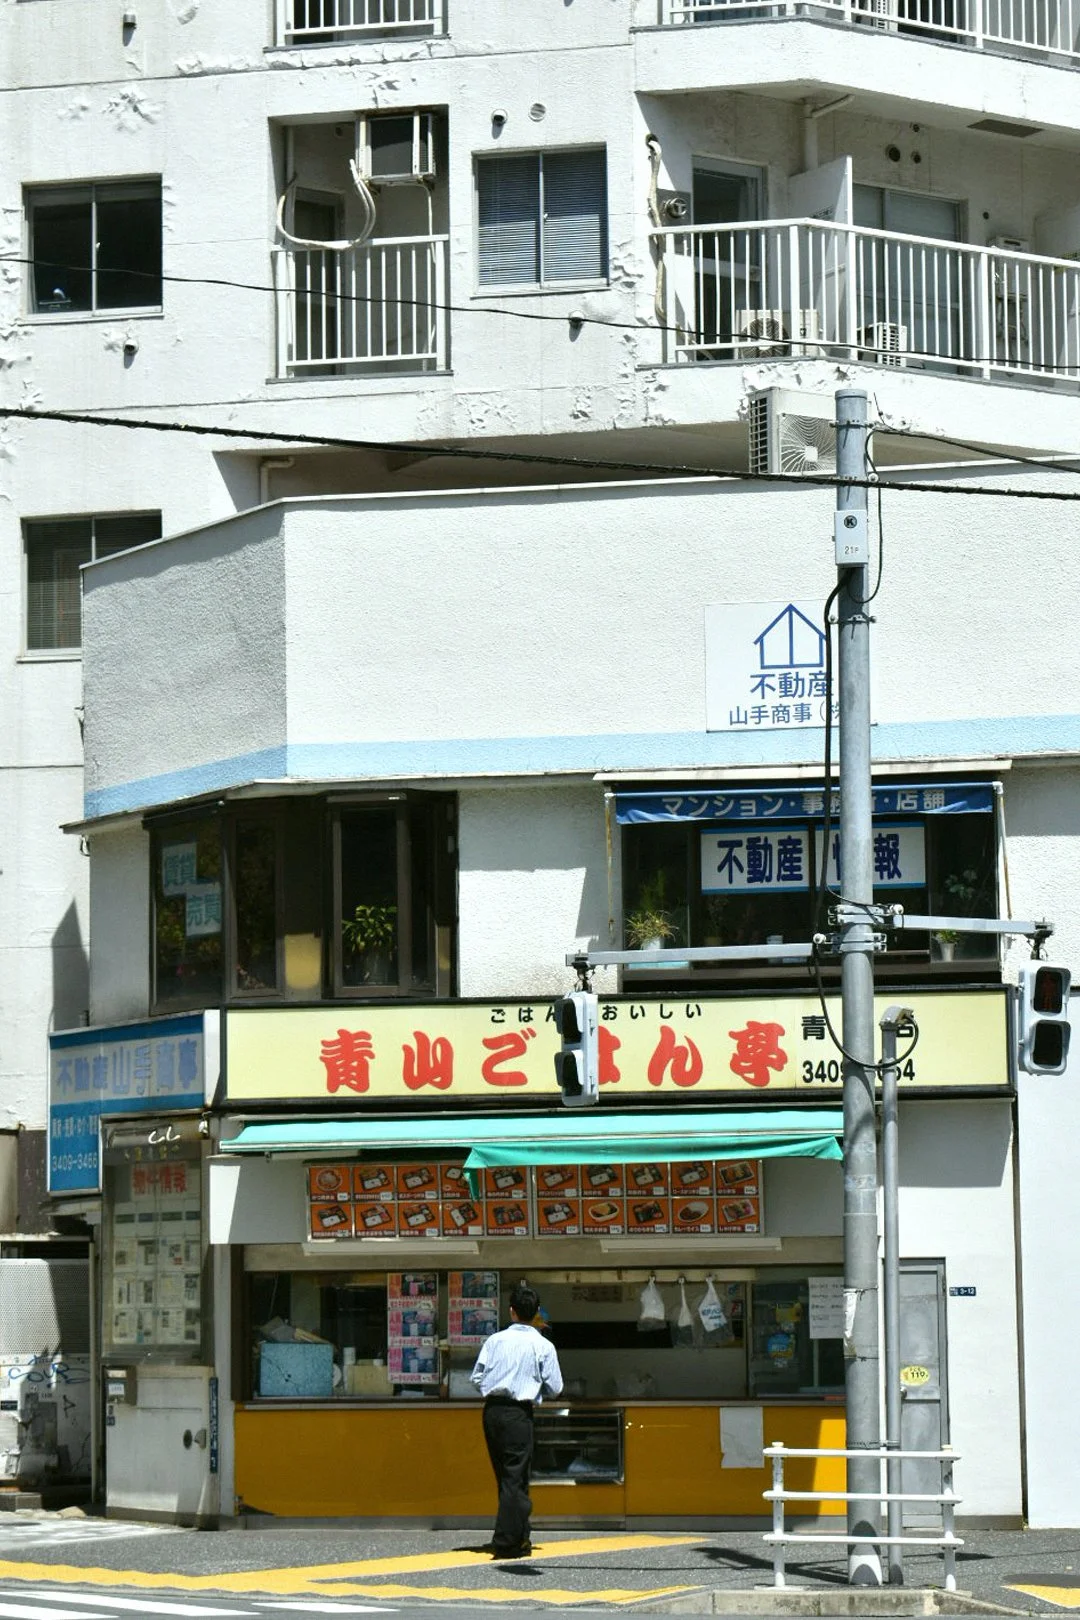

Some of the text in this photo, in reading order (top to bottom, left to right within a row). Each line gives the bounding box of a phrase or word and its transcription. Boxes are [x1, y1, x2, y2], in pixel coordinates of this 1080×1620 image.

[750, 671, 834, 699] 不動産
[490, 1003, 702, 1024] ごはんおいしい
